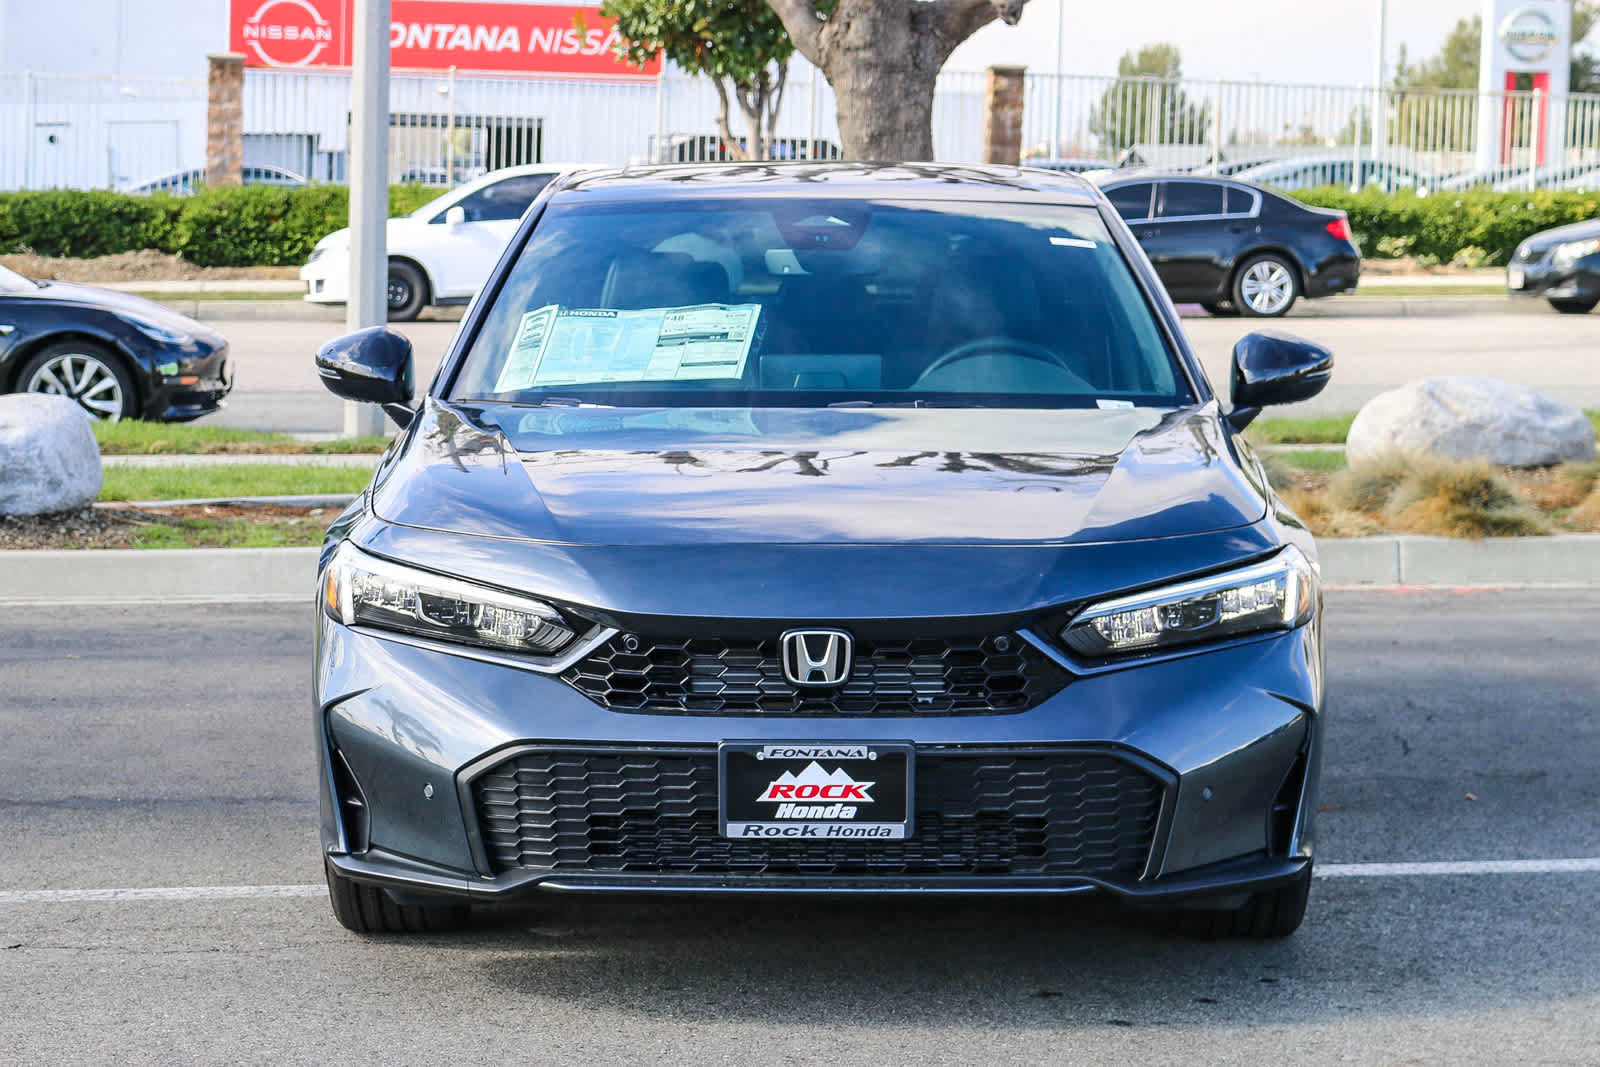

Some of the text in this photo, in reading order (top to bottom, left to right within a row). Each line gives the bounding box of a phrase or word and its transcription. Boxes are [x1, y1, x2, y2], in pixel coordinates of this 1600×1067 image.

[243, 24, 332, 40] NISSAN
[389, 22, 630, 55] ONTANA NISSA
[769, 748, 864, 758] FONTANA
[767, 784, 867, 799] ROCK
[774, 802, 857, 819] Honda
[742, 824, 893, 837] Rock Honda
